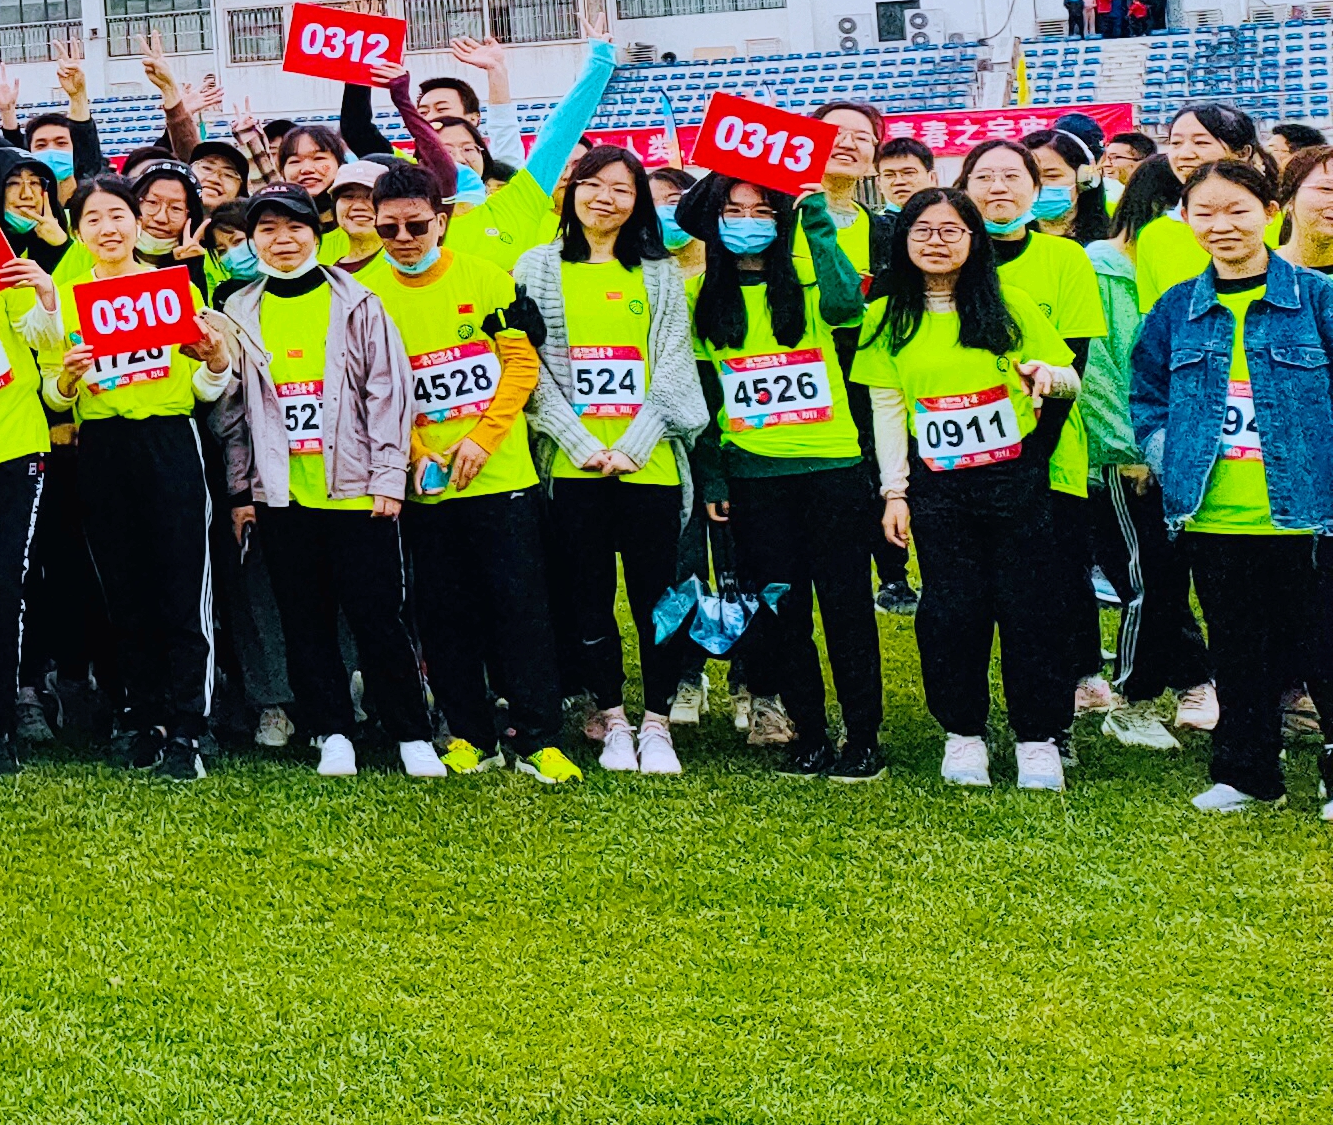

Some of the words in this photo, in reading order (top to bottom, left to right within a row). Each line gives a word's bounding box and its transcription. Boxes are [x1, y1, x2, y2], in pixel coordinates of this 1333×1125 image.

[301, 22, 389, 67] 0312
[715, 115, 815, 172] 0313
[91, 288, 181, 335] 0310
[414, 364, 493, 403] 4528
[734, 372, 818, 408] 4526
[285, 403, 323, 432] 52
[926, 410, 1007, 449] 0911
